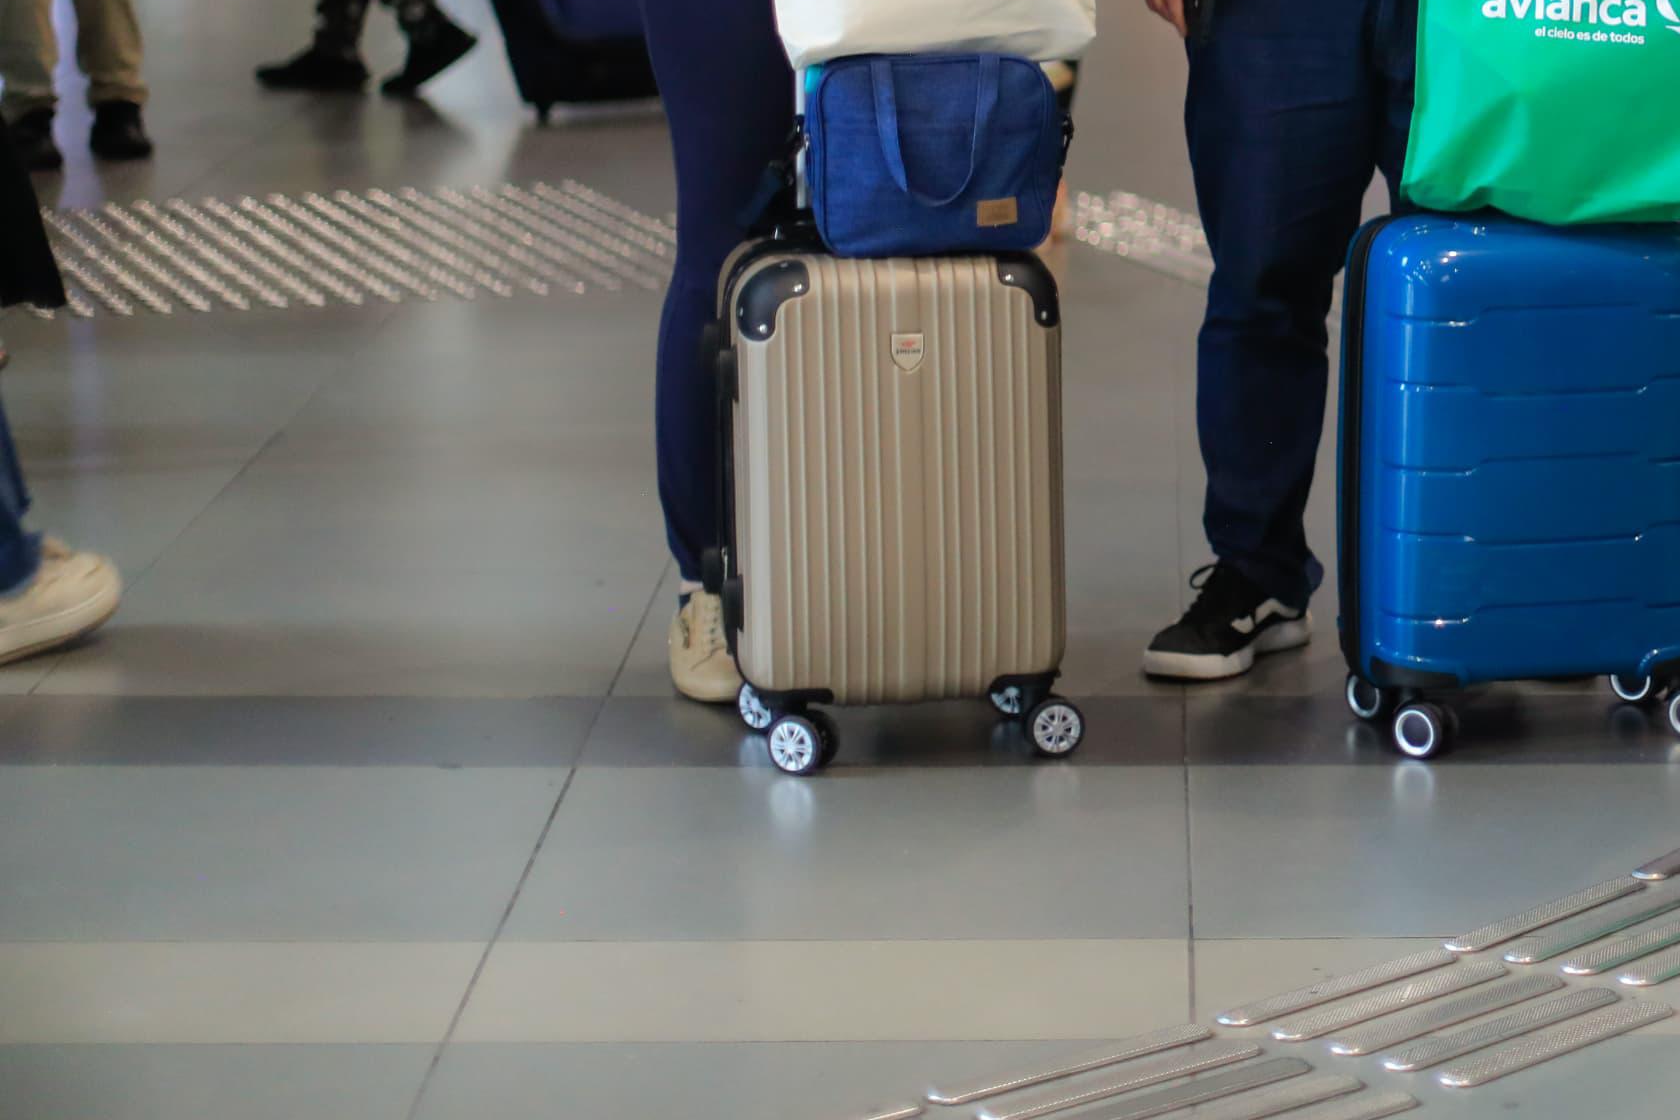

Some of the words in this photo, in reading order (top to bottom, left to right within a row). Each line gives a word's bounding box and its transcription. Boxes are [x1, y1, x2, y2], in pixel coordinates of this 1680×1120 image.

[1535, 26, 1546, 37] el
[1547, 27, 1575, 40] cielo
[1576, 32, 1591, 41] es
[1592, 30, 1608, 42] de
[1609, 31, 1645, 44] todos
